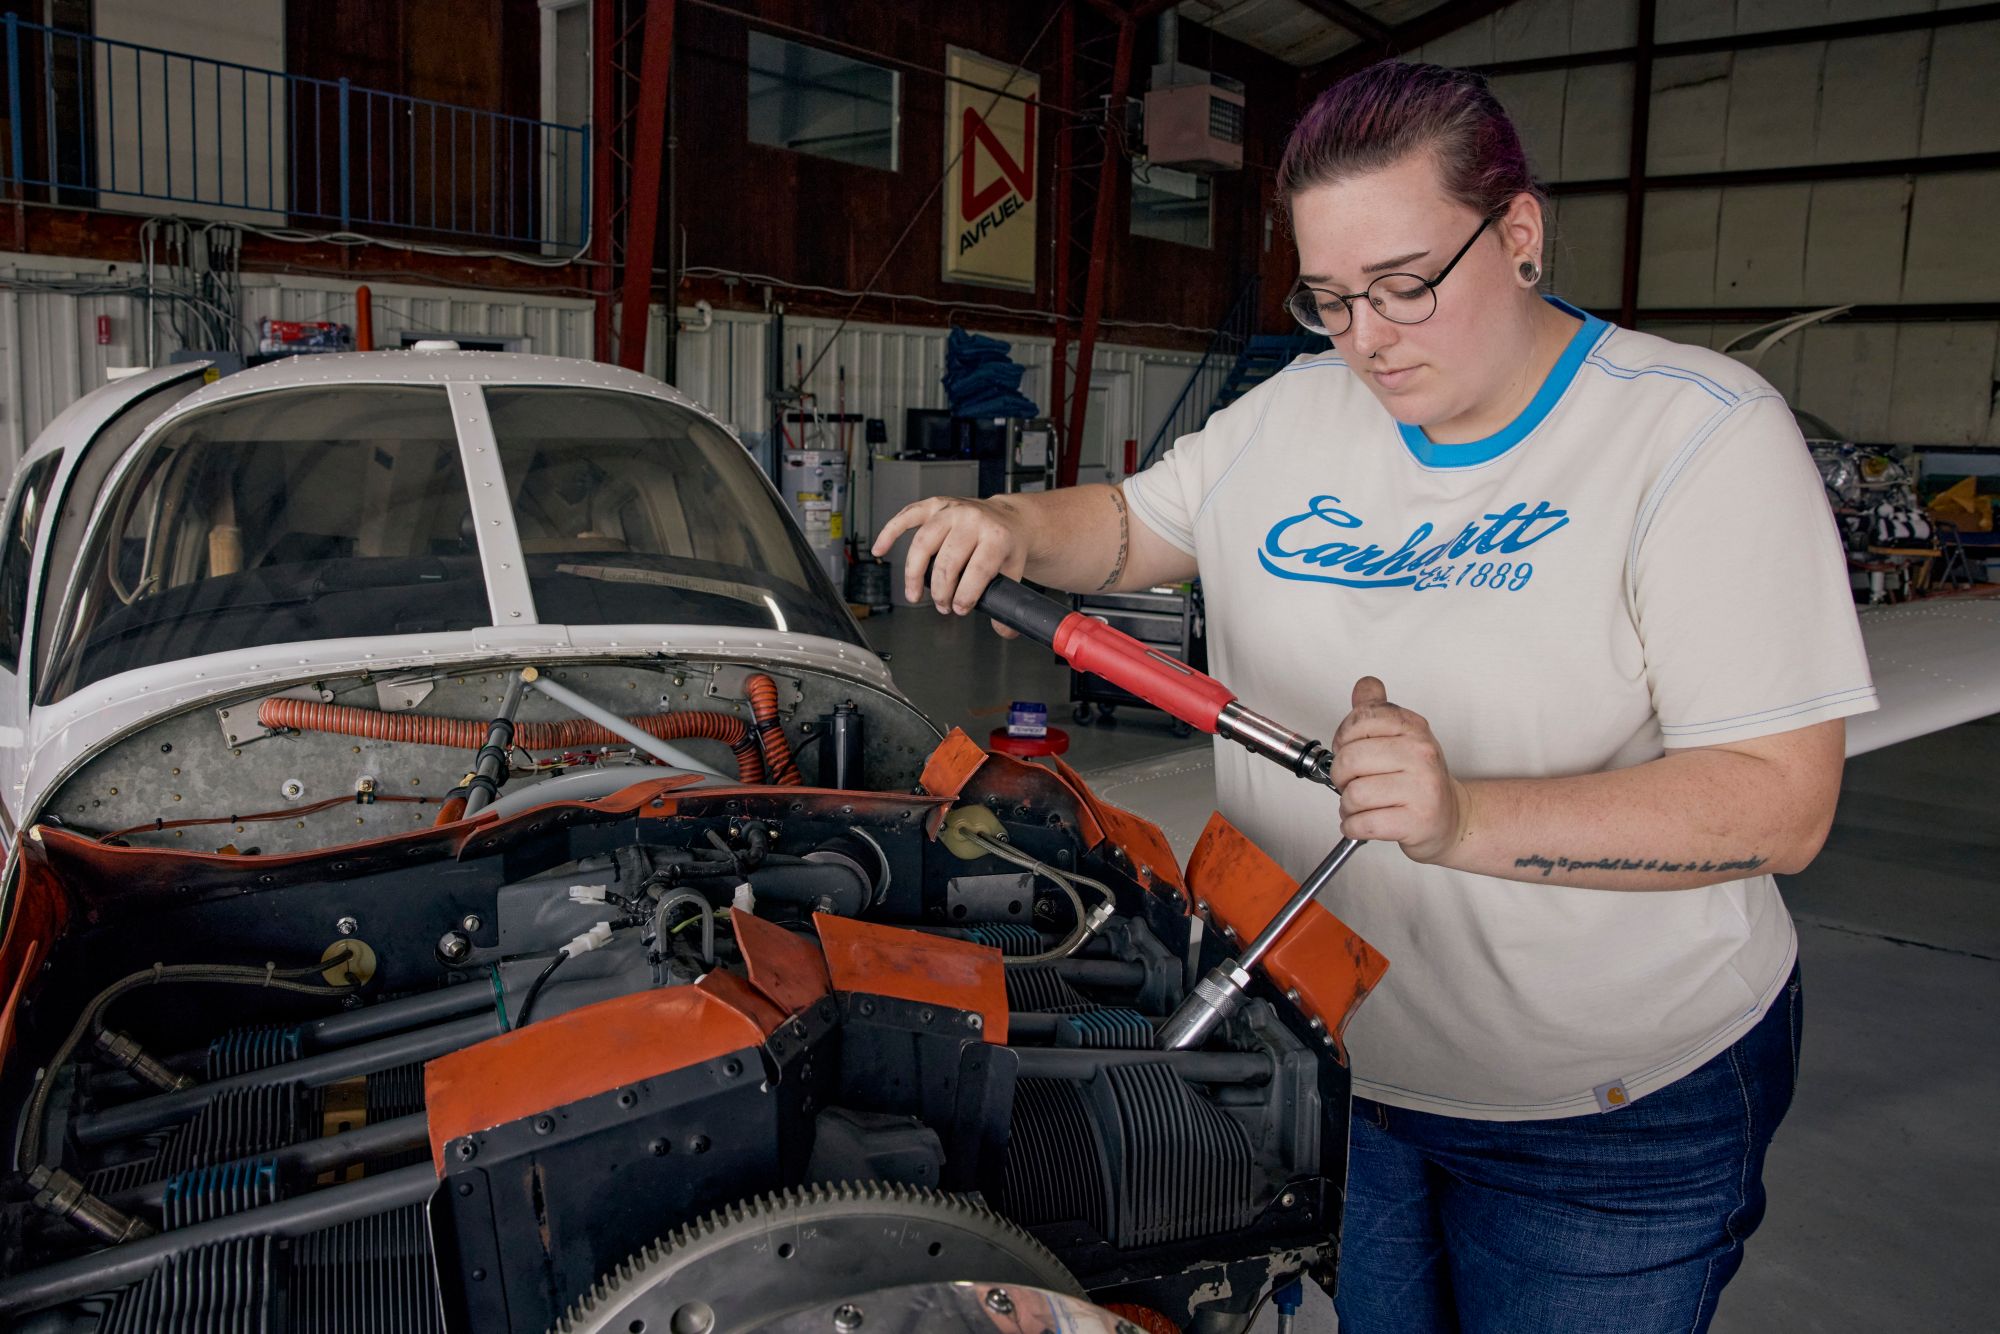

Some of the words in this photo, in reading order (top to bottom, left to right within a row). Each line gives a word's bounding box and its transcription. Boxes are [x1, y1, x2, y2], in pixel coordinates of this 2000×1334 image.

[960, 194, 1025, 255] AVFUEL
[1258, 495, 1570, 588] Carhartt
[1456, 562, 1533, 591] 1889
